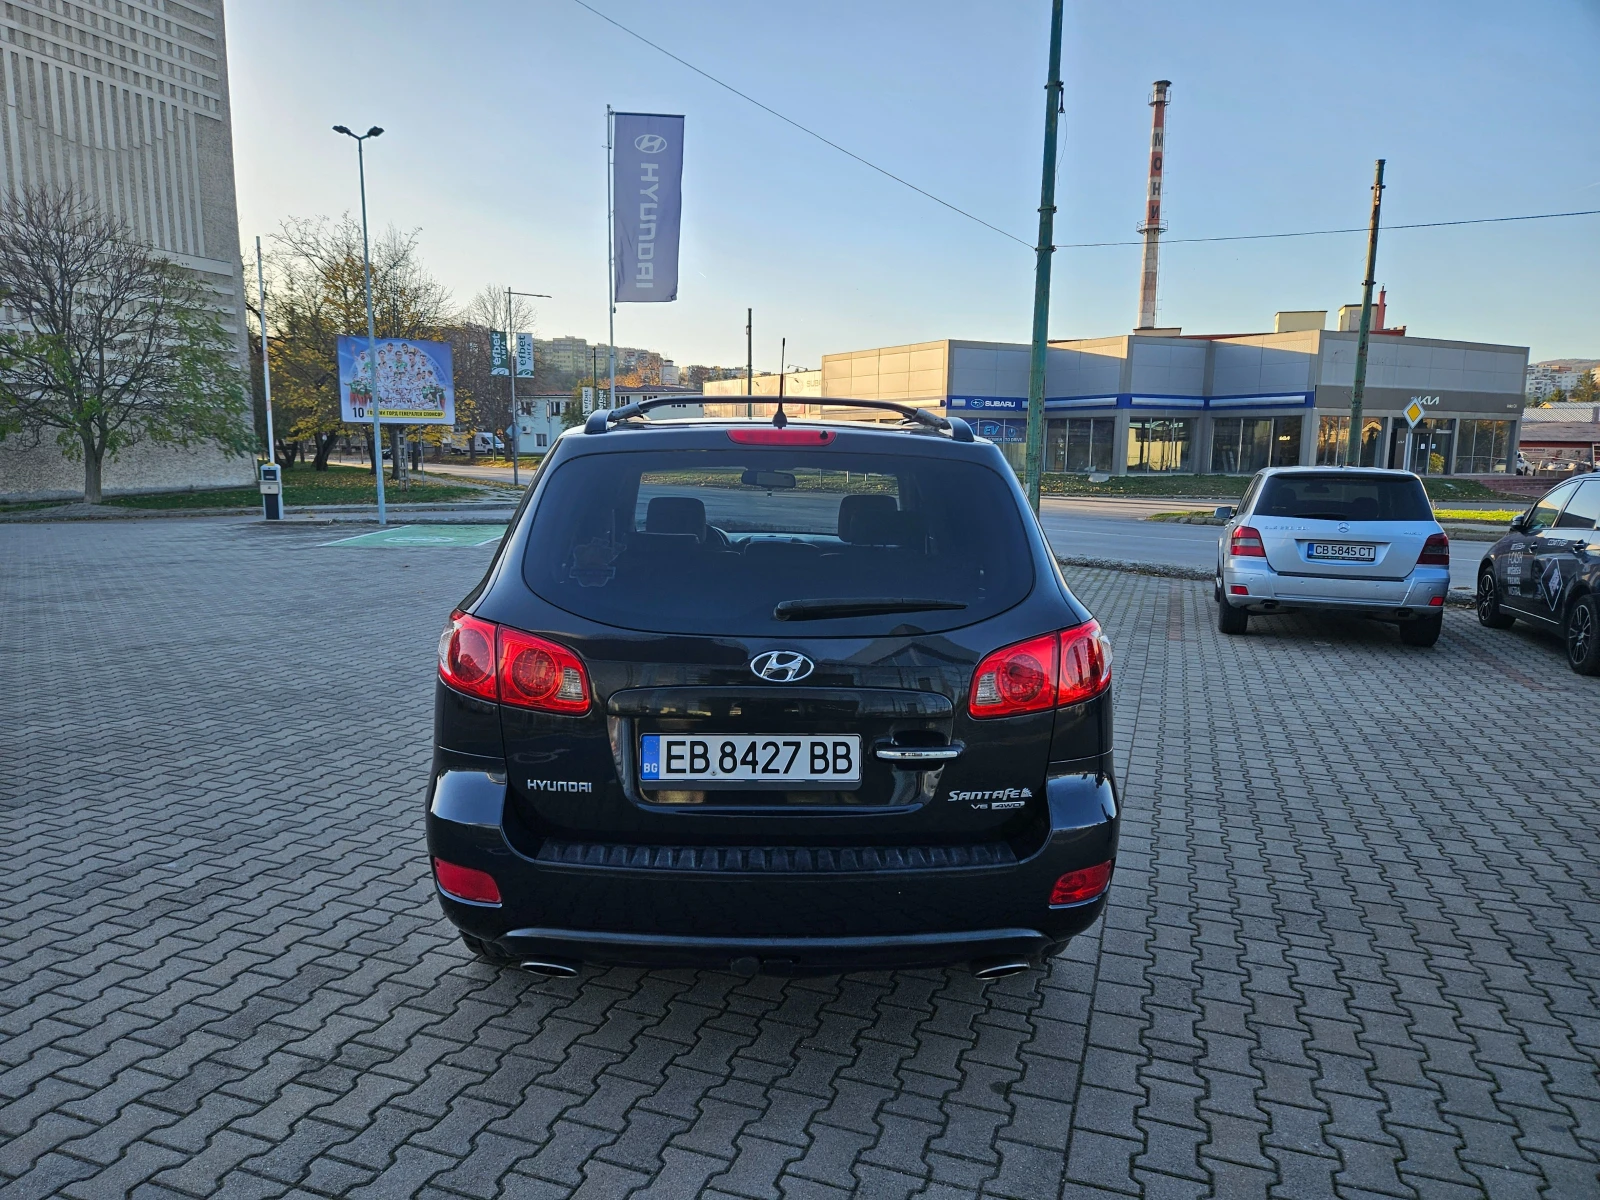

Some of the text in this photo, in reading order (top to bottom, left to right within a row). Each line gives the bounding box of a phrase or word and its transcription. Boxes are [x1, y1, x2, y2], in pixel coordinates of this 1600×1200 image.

[1151, 132, 1163, 219] МОНИ
[635, 162, 659, 288] HYUNDAI
[492, 333, 502, 365] efbet
[518, 335, 527, 366] efbet
[985, 400, 1016, 408] SUBARU
[1418, 395, 1440, 405] KIA
[352, 407, 364, 418] 10
[983, 425, 1000, 436] EV
[1315, 545, 1374, 557] CB 5845 CT
[666, 740, 853, 774] EB 8427 BB
[643, 762, 658, 774] BG
[527, 779, 592, 793] HYUNDAI
